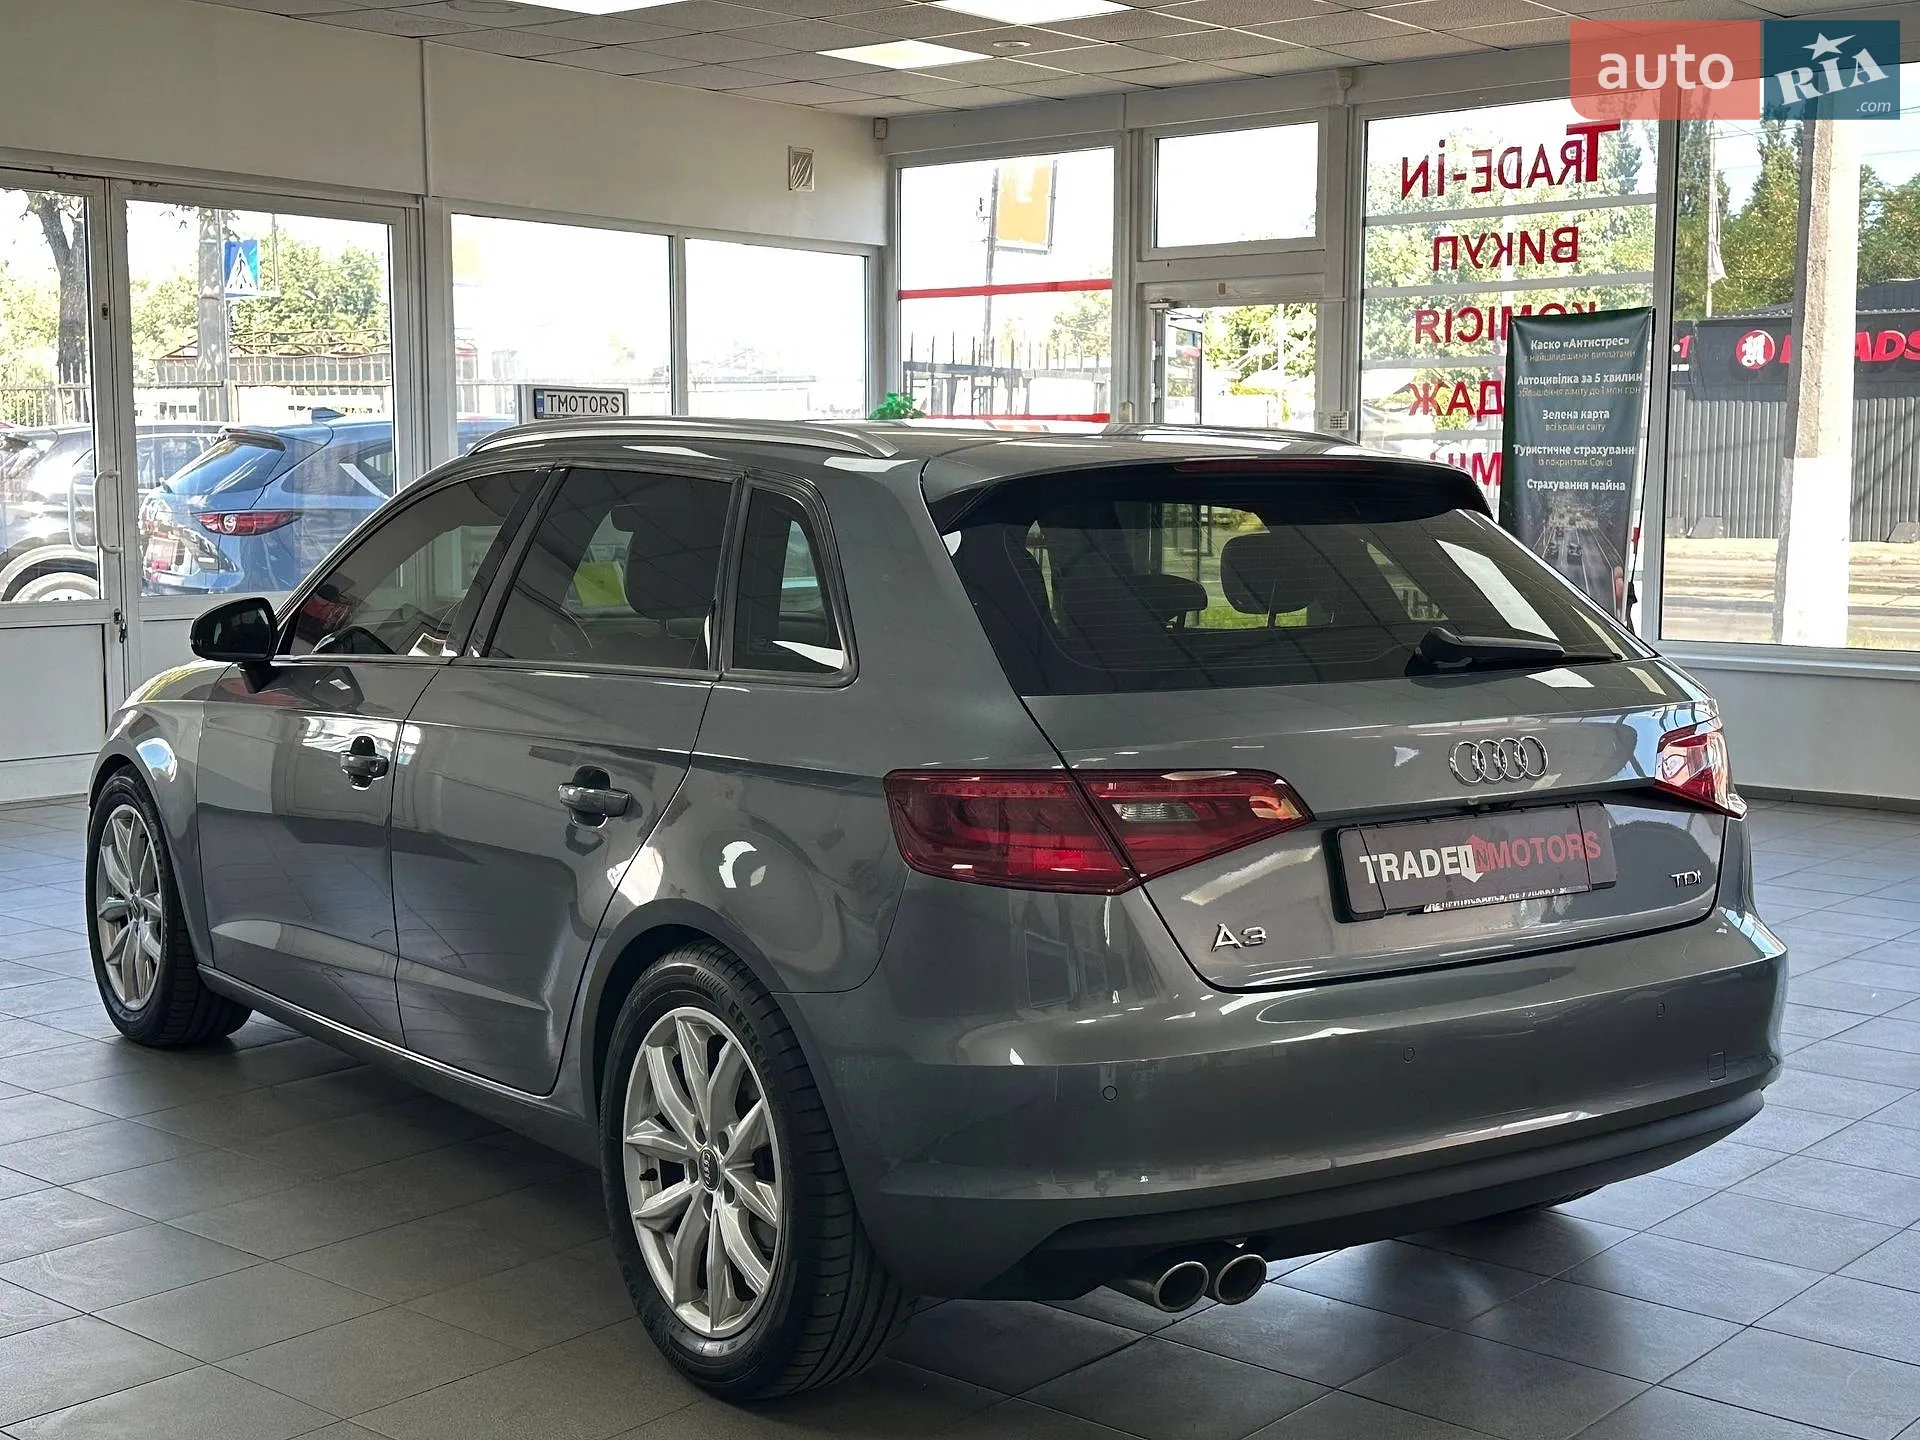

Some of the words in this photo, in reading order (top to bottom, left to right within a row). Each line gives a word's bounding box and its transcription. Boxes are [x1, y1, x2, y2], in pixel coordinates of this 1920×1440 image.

[1531, 339, 1561, 350] Каско
[1563, 336, 1630, 349] «Антистрес»
[1517, 372, 1579, 386] Автоцивілка
[1581, 375, 1593, 384] за
[1594, 373, 1601, 383] 5
[1603, 372, 1643, 383] хвилин
[546, 394, 620, 414] TMOTORS
[1542, 409, 1579, 420] Зелена
[1581, 410, 1610, 421] карта
[1513, 443, 1572, 457] Туристичне
[1527, 478, 1589, 491] Страхування
[1591, 479, 1626, 491] майна
[1670, 870, 1701, 888] TDI
[1210, 922, 1267, 952] A3
